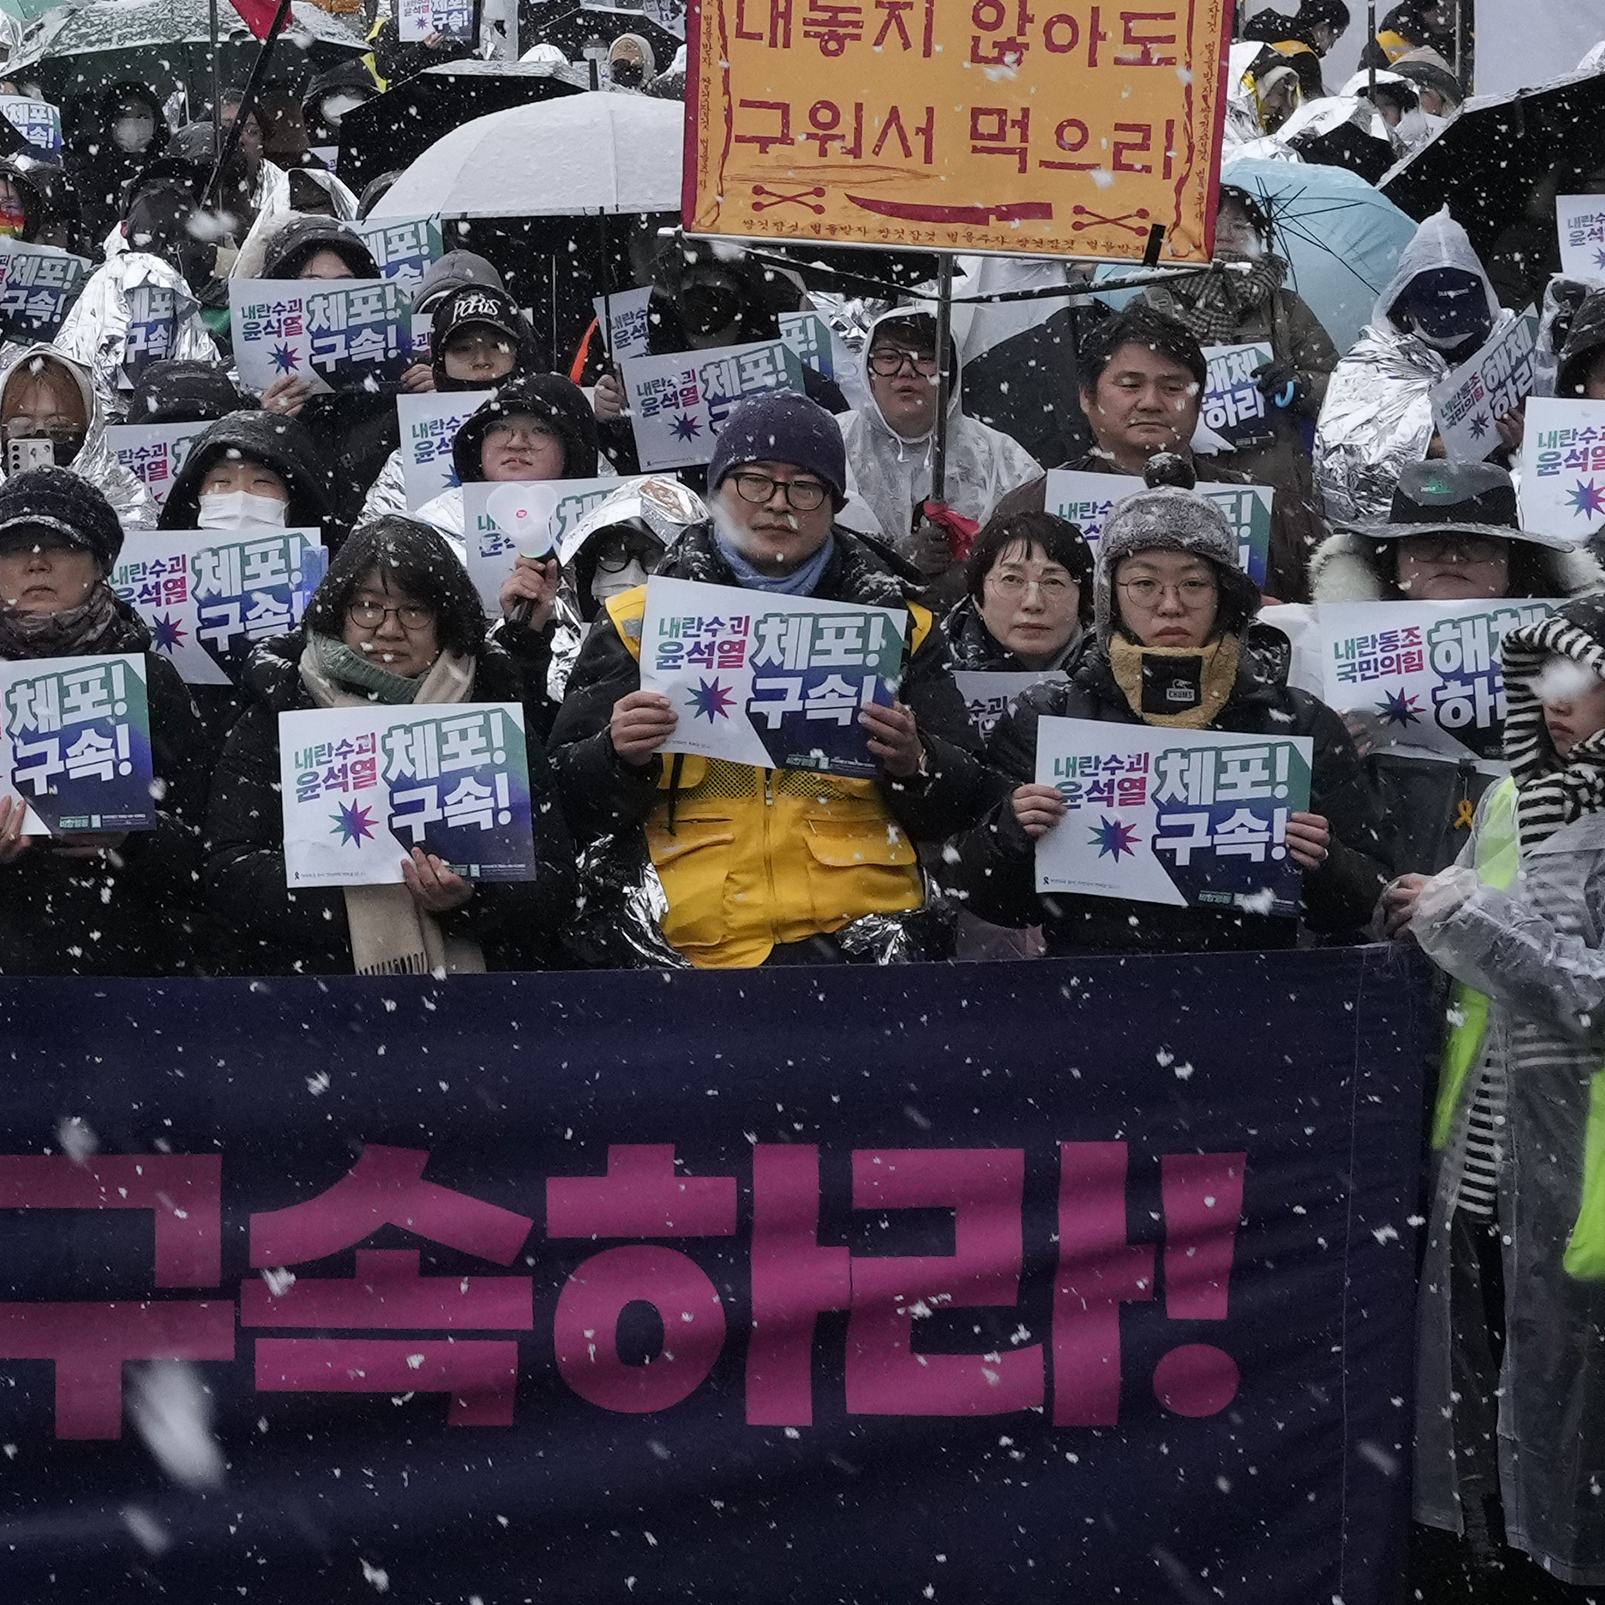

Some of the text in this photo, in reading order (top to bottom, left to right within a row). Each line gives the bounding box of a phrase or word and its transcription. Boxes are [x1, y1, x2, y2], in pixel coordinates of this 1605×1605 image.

[734, 99, 1176, 180] 구워서 먹으리
[12, 255, 75, 287] 체포!
[6, 286, 65, 320] 구속!
[241, 297, 302, 320] 내란수괴
[307, 285, 395, 332] 체포!
[242, 315, 303, 340] 윤석열
[310, 326, 396, 372] 구속!
[636, 368, 696, 395] 내란수괴
[701, 344, 789, 398] 체포!
[641, 385, 700, 416] 윤석열
[193, 534, 303, 596] 체포!
[658, 616, 750, 639] 내란수괴
[753, 615, 886, 670] 체포!
[1334, 627, 1422, 658] 내란동조
[655, 639, 745, 669] 윤석열
[1336, 652, 1423, 683] 국민의힘
[8, 662, 128, 736] 체포!
[750, 674, 877, 729] 구속!
[15, 724, 131, 796] 구속!
[294, 733, 376, 768] 내란수괴
[388, 711, 506, 781] 체포!
[1054, 754, 1150, 777] 내란수괴
[296, 760, 376, 800] 윤석열
[1156, 744, 1290, 803] 체포!
[392, 772, 511, 841] 구속!
[1155, 811, 1288, 865] 구속!
